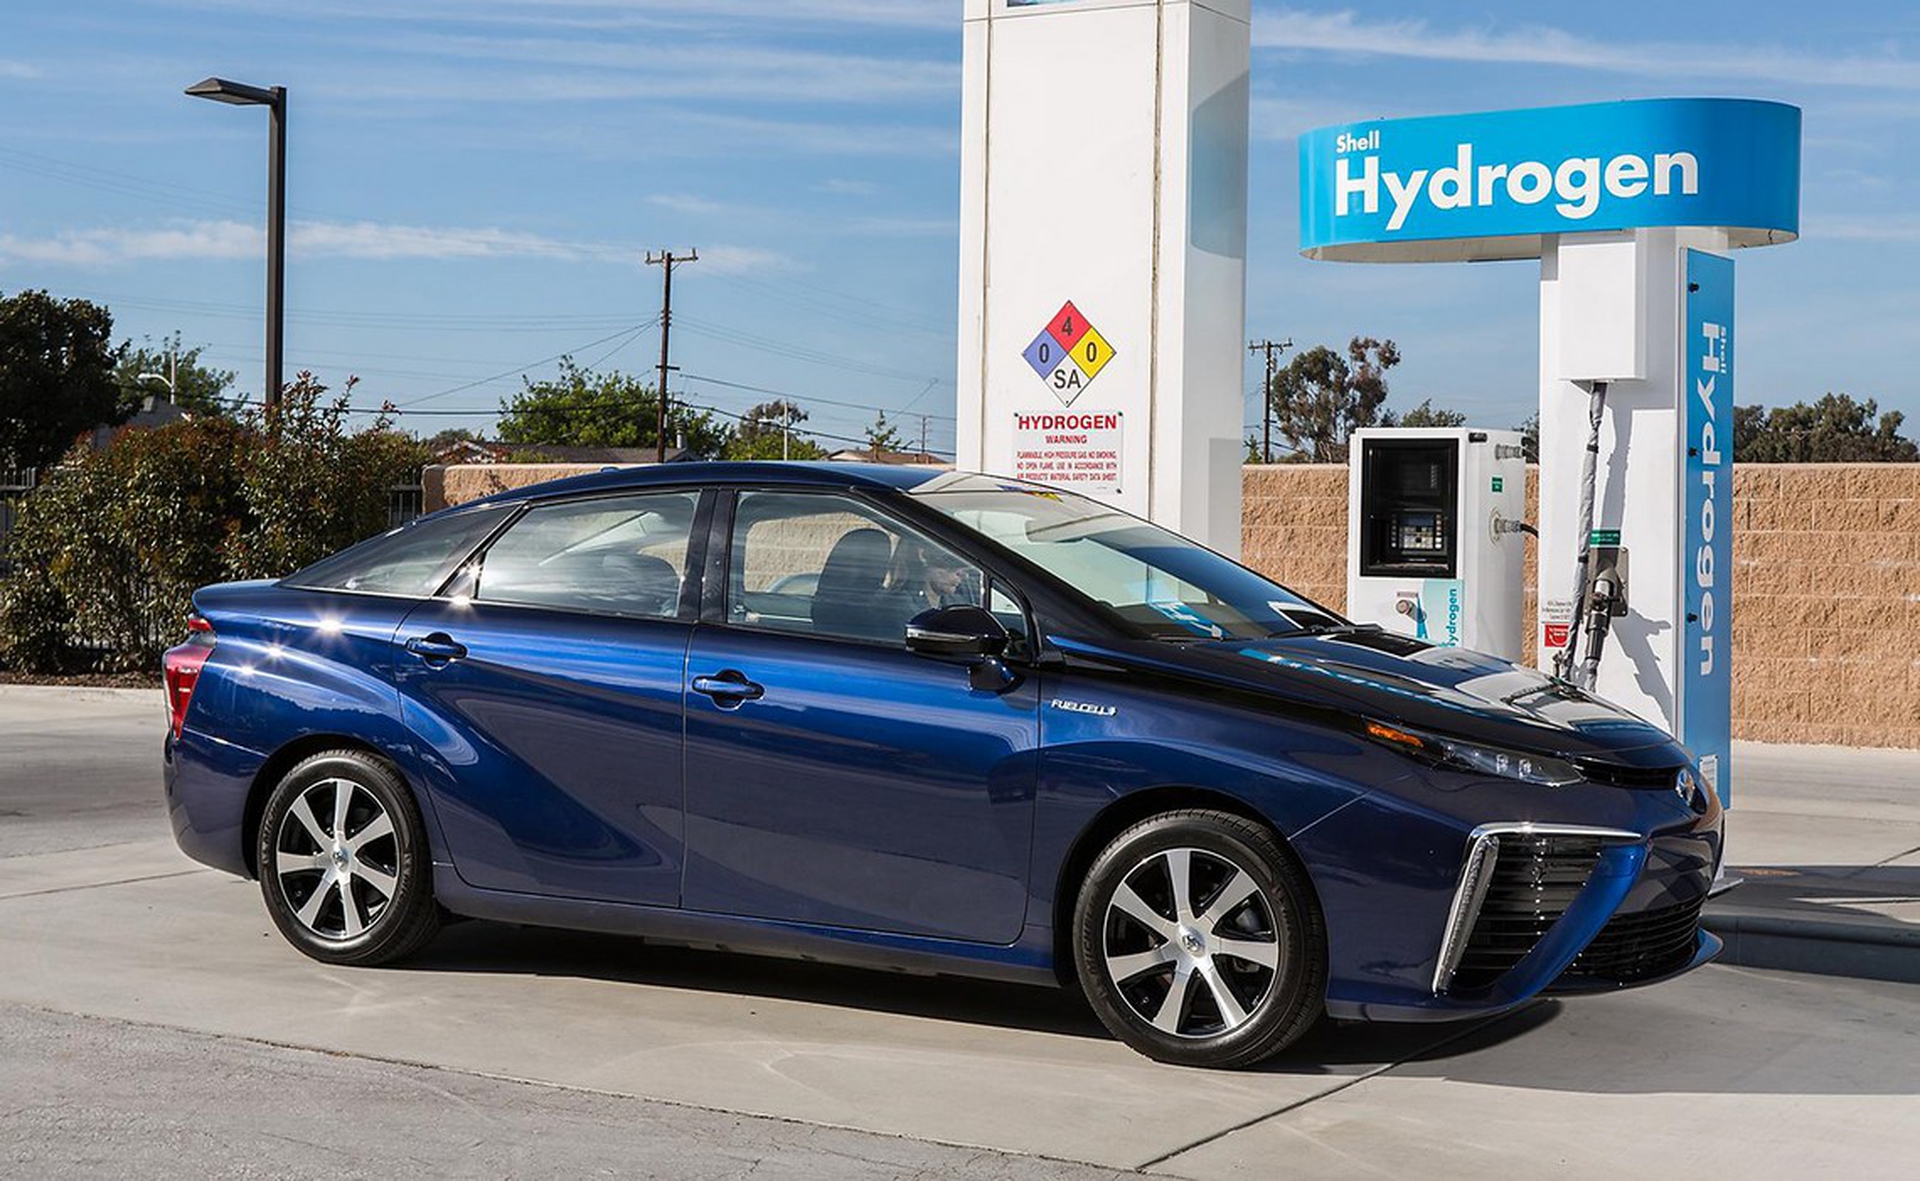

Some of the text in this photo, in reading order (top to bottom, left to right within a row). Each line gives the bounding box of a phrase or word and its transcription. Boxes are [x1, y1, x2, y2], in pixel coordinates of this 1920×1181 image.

[1336, 130, 1380, 153] Shell
[1335, 144, 1699, 231] Hydrogen
[1061, 316, 1073, 336] 4
[1039, 343, 1050, 364] 0
[1086, 341, 1097, 363] 0
[1054, 368, 1082, 389] SA
[1018, 415, 1117, 430] HYDROGEN
[1045, 434, 1088, 444] WARNING
[1697, 322, 1721, 677] Hydrogen
